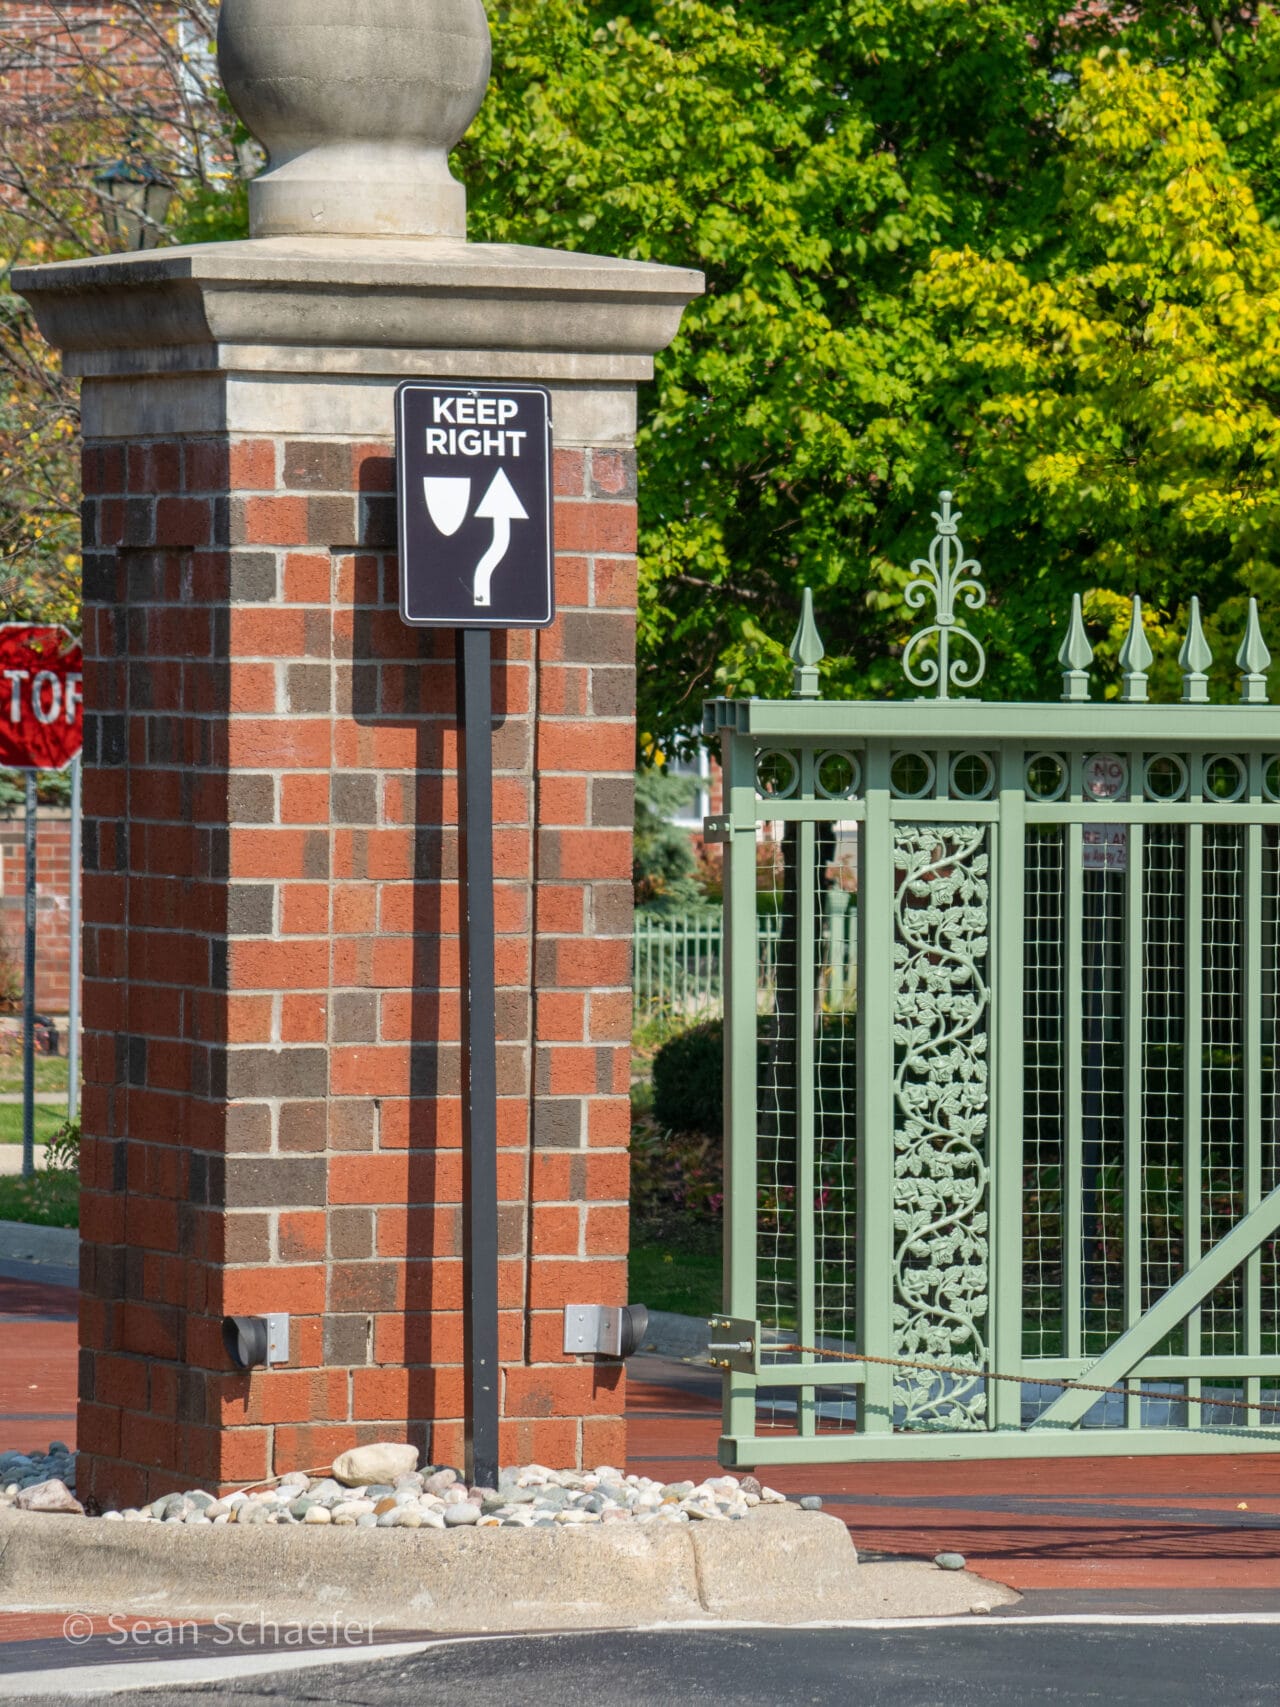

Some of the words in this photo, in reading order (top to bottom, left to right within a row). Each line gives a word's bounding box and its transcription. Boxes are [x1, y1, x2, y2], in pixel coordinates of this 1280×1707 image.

[432, 396, 519, 426] KEEP
[425, 427, 527, 457] RIGHT
[3, 669, 83, 725] TOP
